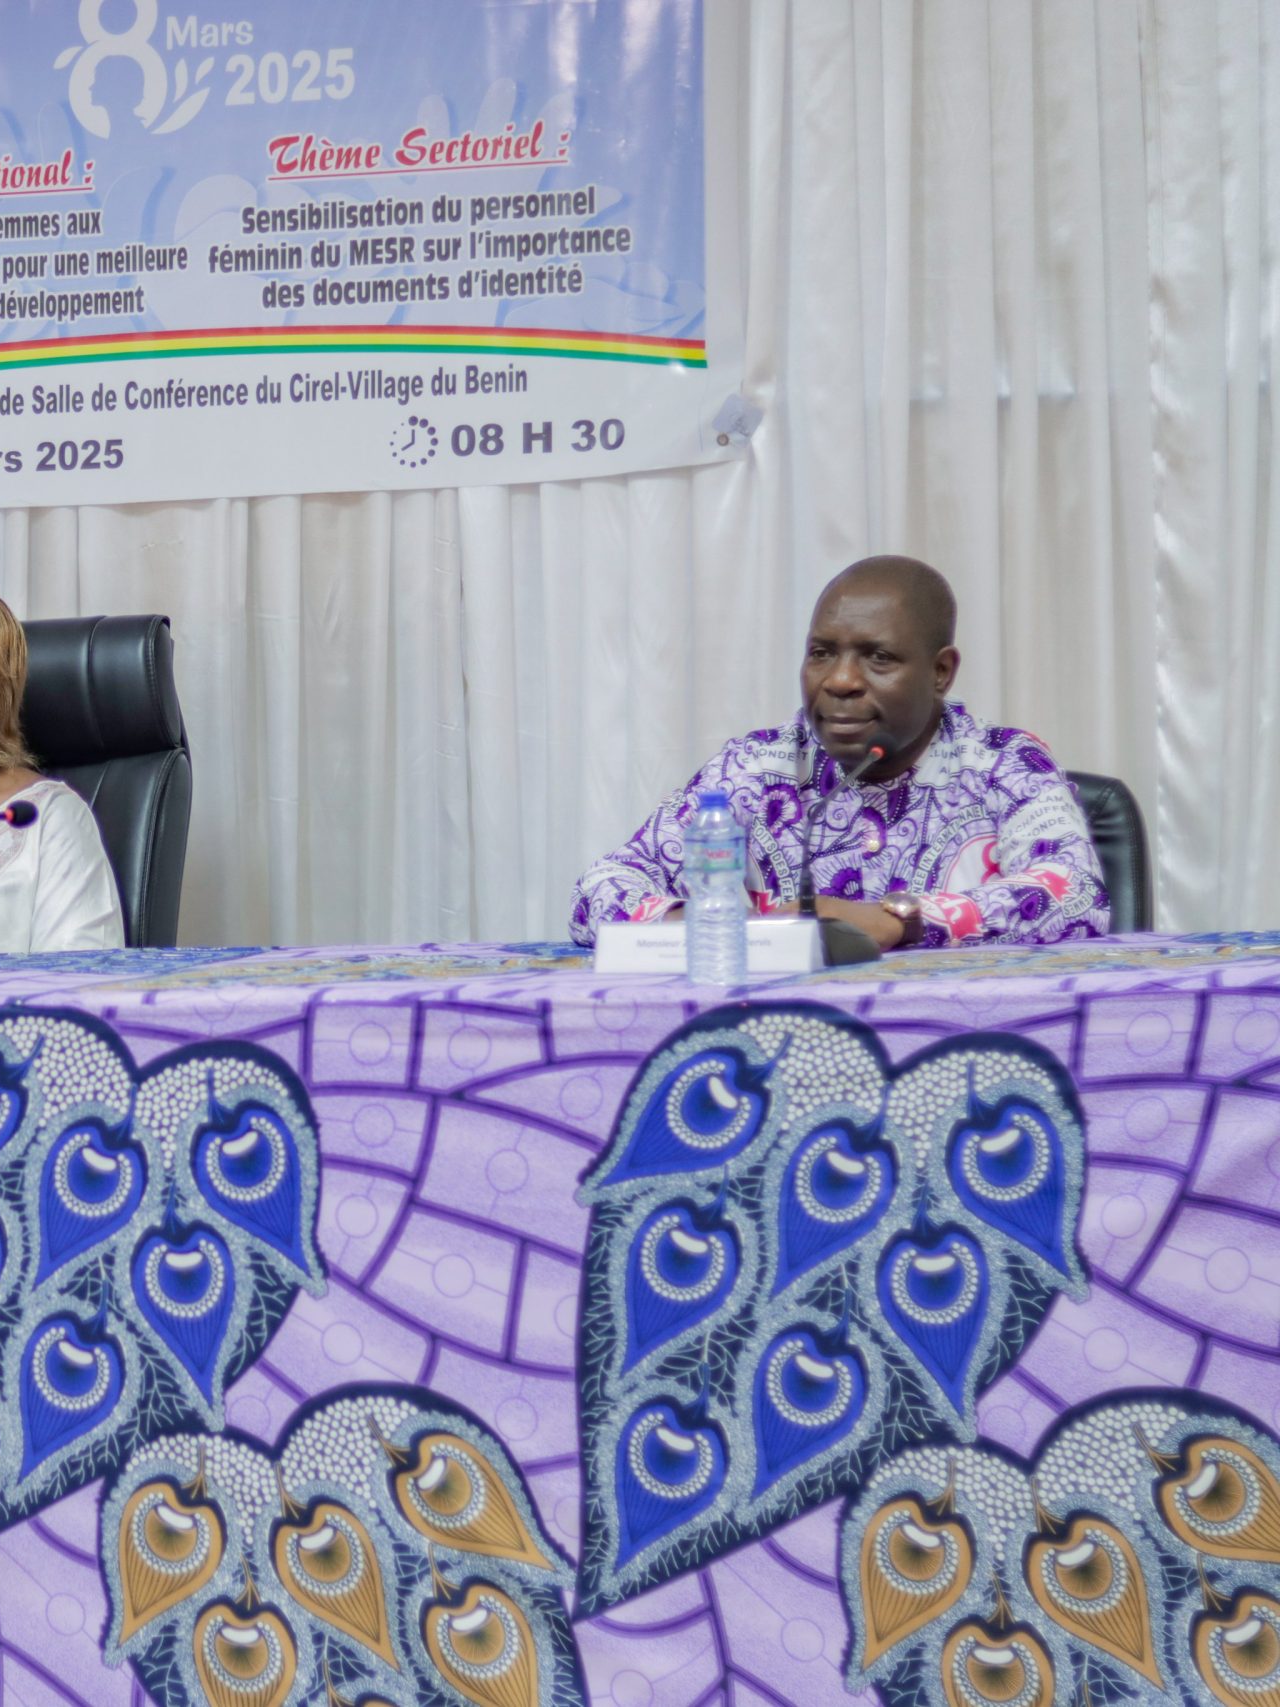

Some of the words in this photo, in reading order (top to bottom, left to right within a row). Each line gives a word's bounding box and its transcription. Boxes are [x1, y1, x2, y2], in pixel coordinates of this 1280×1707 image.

[166, 15, 255, 50] Mars
[224, 48, 357, 106] 2025
[269, 135, 381, 174] Thème
[395, 122, 544, 166] Sectoriel
[559, 134, 568, 155] :
[84, 162, 93, 184] :
[67, 211, 101, 235] aux
[242, 199, 424, 234] Sensibilisation
[431, 195, 462, 223] du
[470, 186, 595, 226] personnel
[2, 255, 48, 283] pour
[54, 252, 90, 277] une
[96, 245, 188, 274] meilleure
[208, 242, 302, 273] féminin
[310, 240, 341, 268] du
[349, 236, 415, 266] MESR
[423, 237, 462, 262] sur
[470, 227, 631, 262] l'importance
[262, 281, 305, 309] des
[313, 273, 450, 306] documents
[458, 263, 582, 298] d'identité
[31, 384, 84, 415] Salle
[91, 383, 117, 412] de
[123, 377, 249, 411] Conférence
[255, 375, 281, 404] du
[289, 369, 424, 406] Cirel-Village
[431, 366, 457, 396] du
[465, 363, 527, 394] Benin
[36, 439, 124, 472] 2025
[451, 423, 504, 457] 08
[522, 421, 553, 454] H
[572, 418, 625, 452] 30
